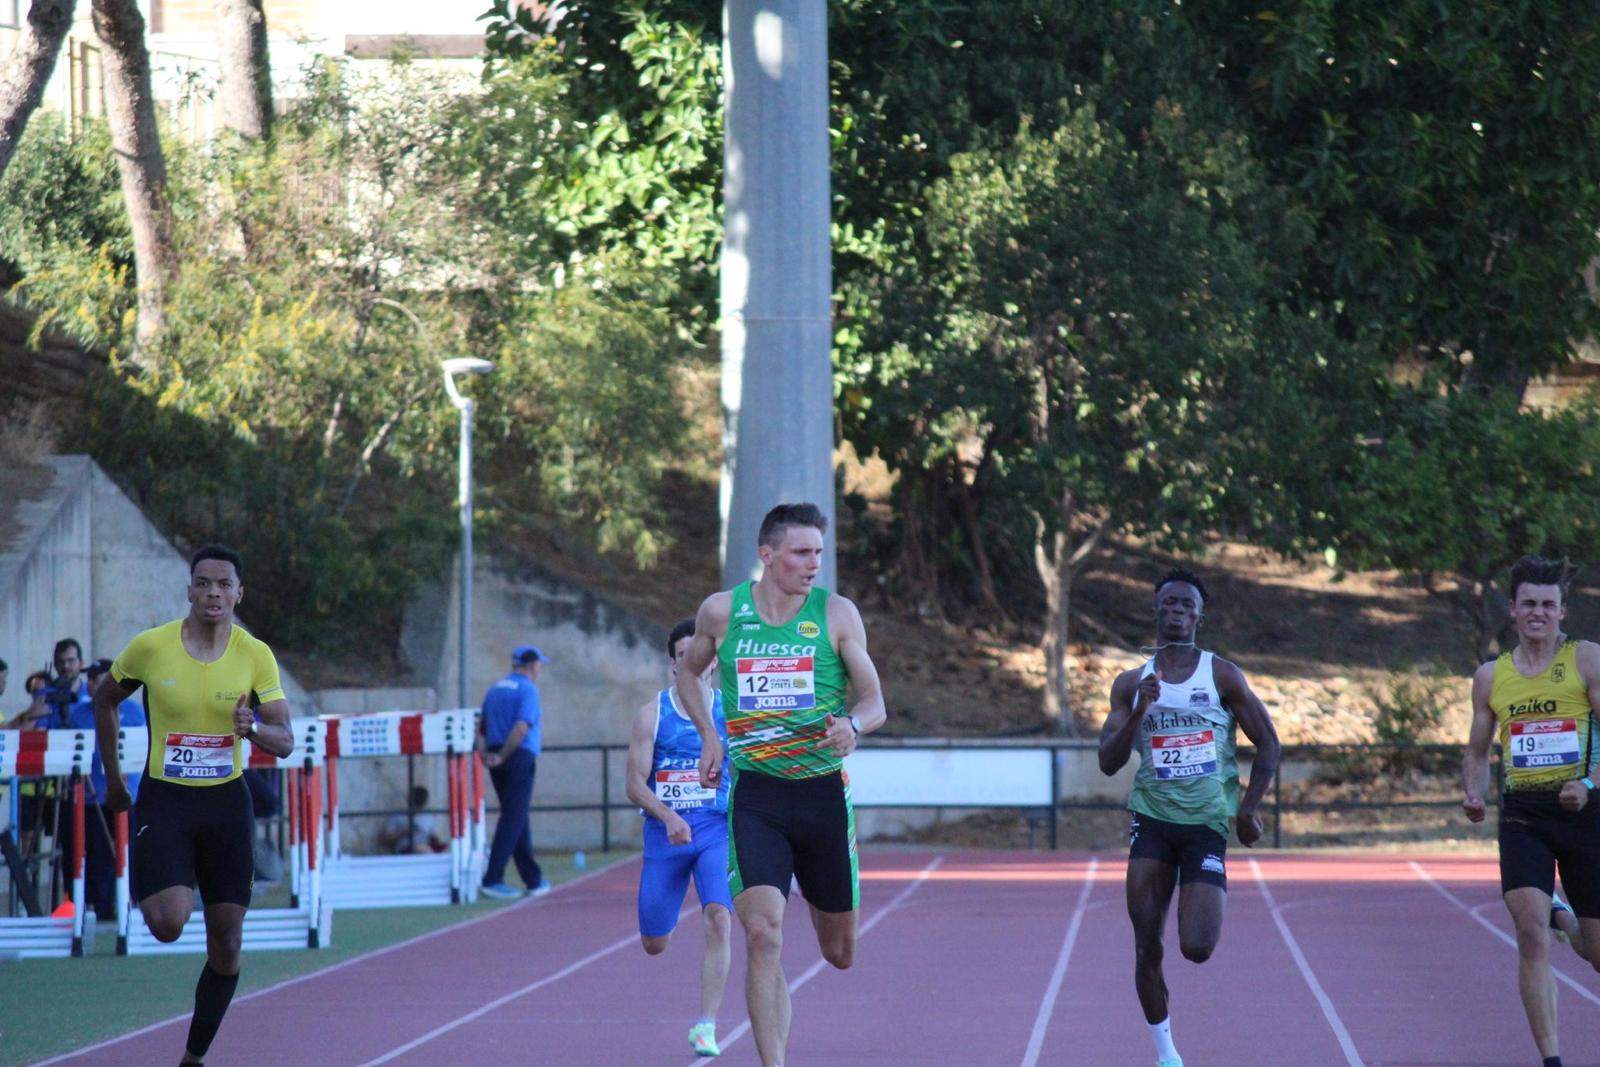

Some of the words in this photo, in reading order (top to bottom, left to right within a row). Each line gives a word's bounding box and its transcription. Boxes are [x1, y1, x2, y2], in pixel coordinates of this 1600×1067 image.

[735, 639, 816, 656] Huesca
[746, 676, 768, 692] 12
[1517, 737, 1535, 752] 19
[171, 747, 193, 763] 20
[1161, 749, 1182, 764] 22
[662, 785, 681, 798] 26
